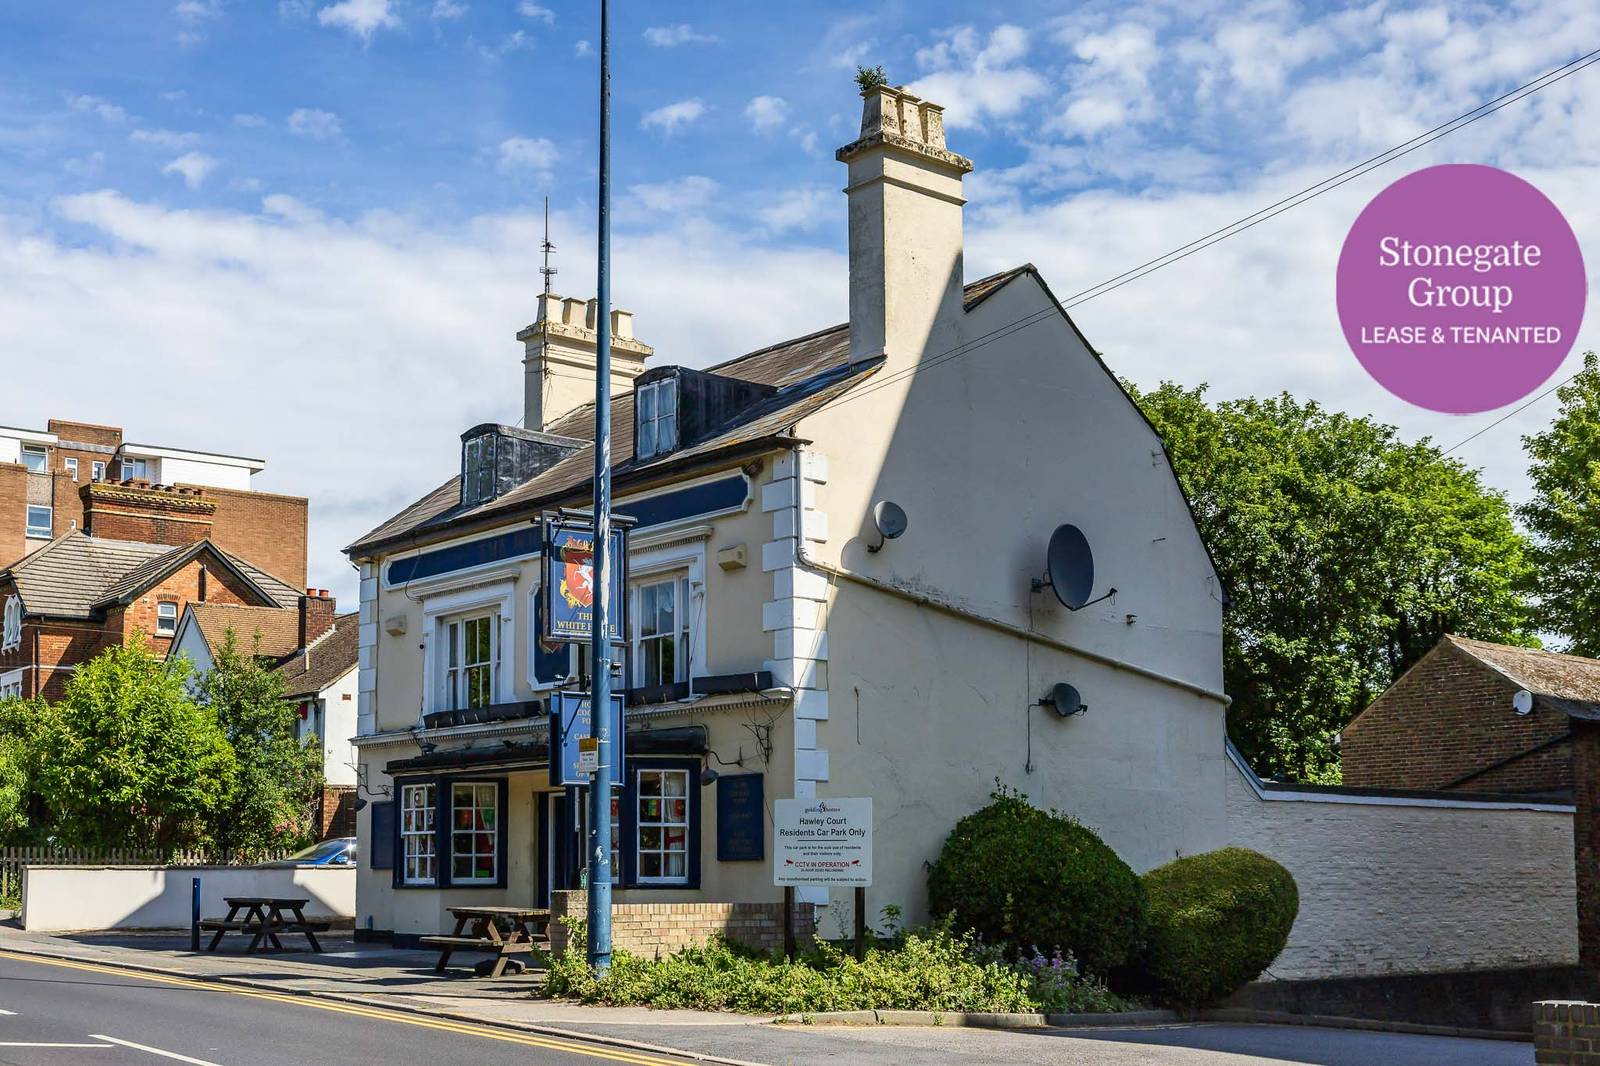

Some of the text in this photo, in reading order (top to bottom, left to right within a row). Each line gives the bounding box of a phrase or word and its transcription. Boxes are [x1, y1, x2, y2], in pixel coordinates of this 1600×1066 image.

[557, 620, 586, 630] WHITE
[800, 818, 824, 826] Hawley
[849, 829, 866, 837] Only
